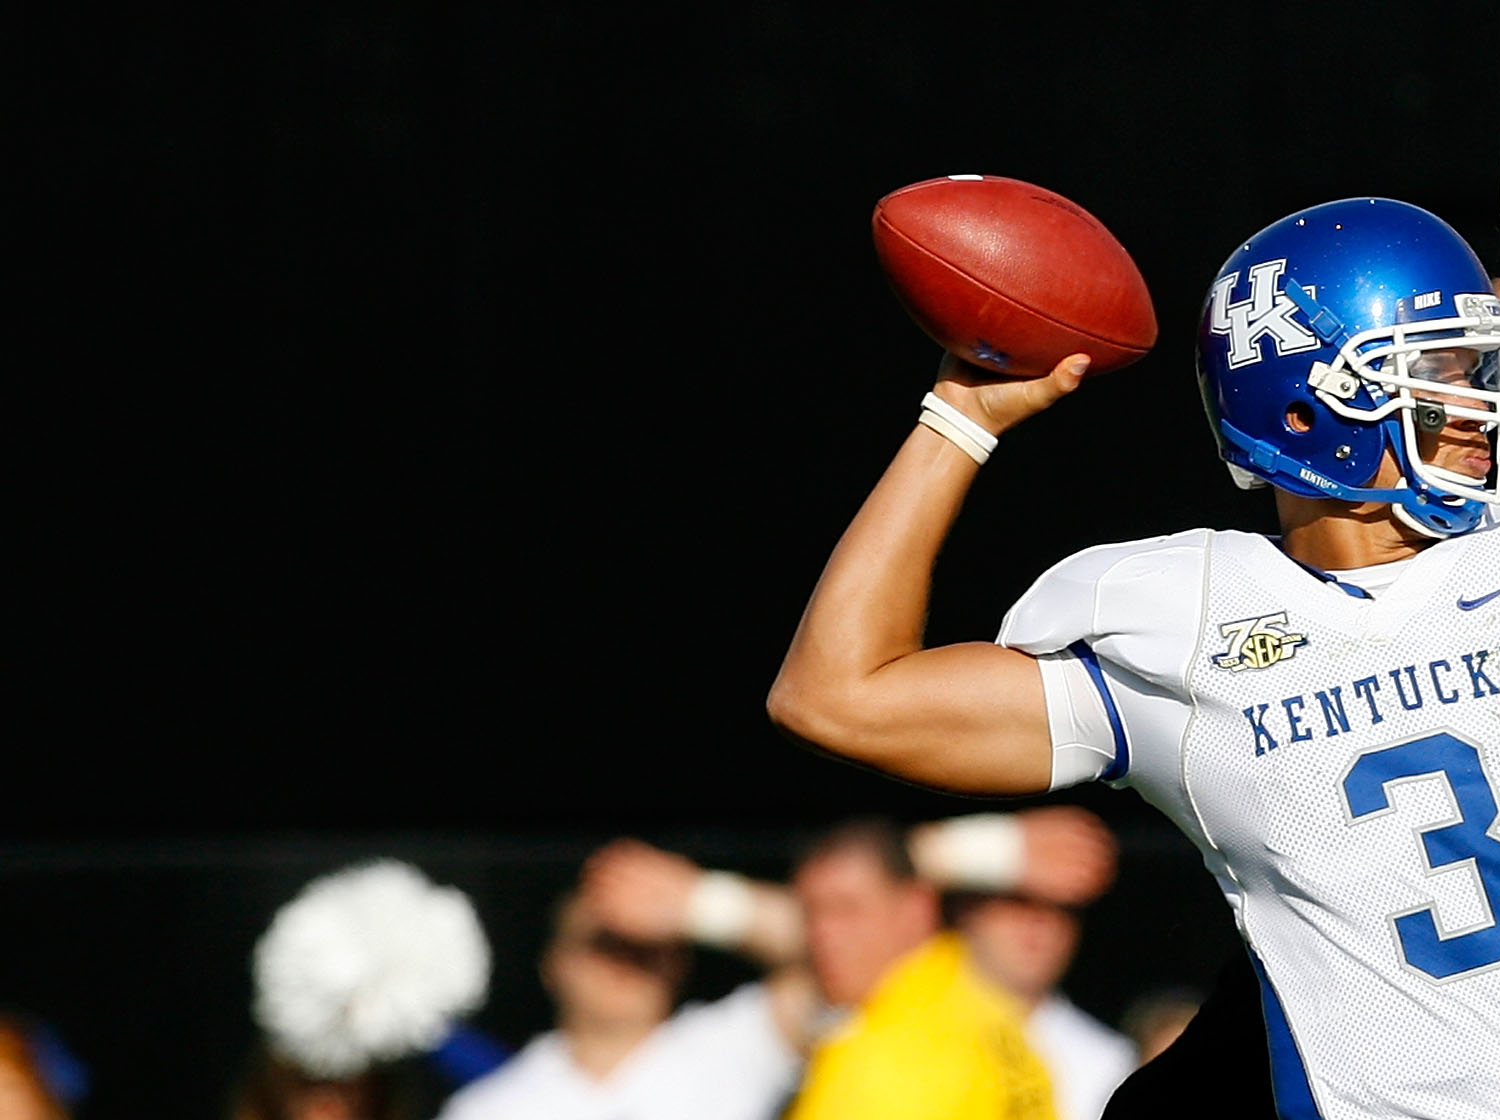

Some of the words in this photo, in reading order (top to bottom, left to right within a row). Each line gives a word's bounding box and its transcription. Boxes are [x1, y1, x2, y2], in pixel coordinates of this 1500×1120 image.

[1211, 258, 1321, 370] UK
[1219, 611, 1297, 662] 75
[1241, 633, 1282, 669] SEC
